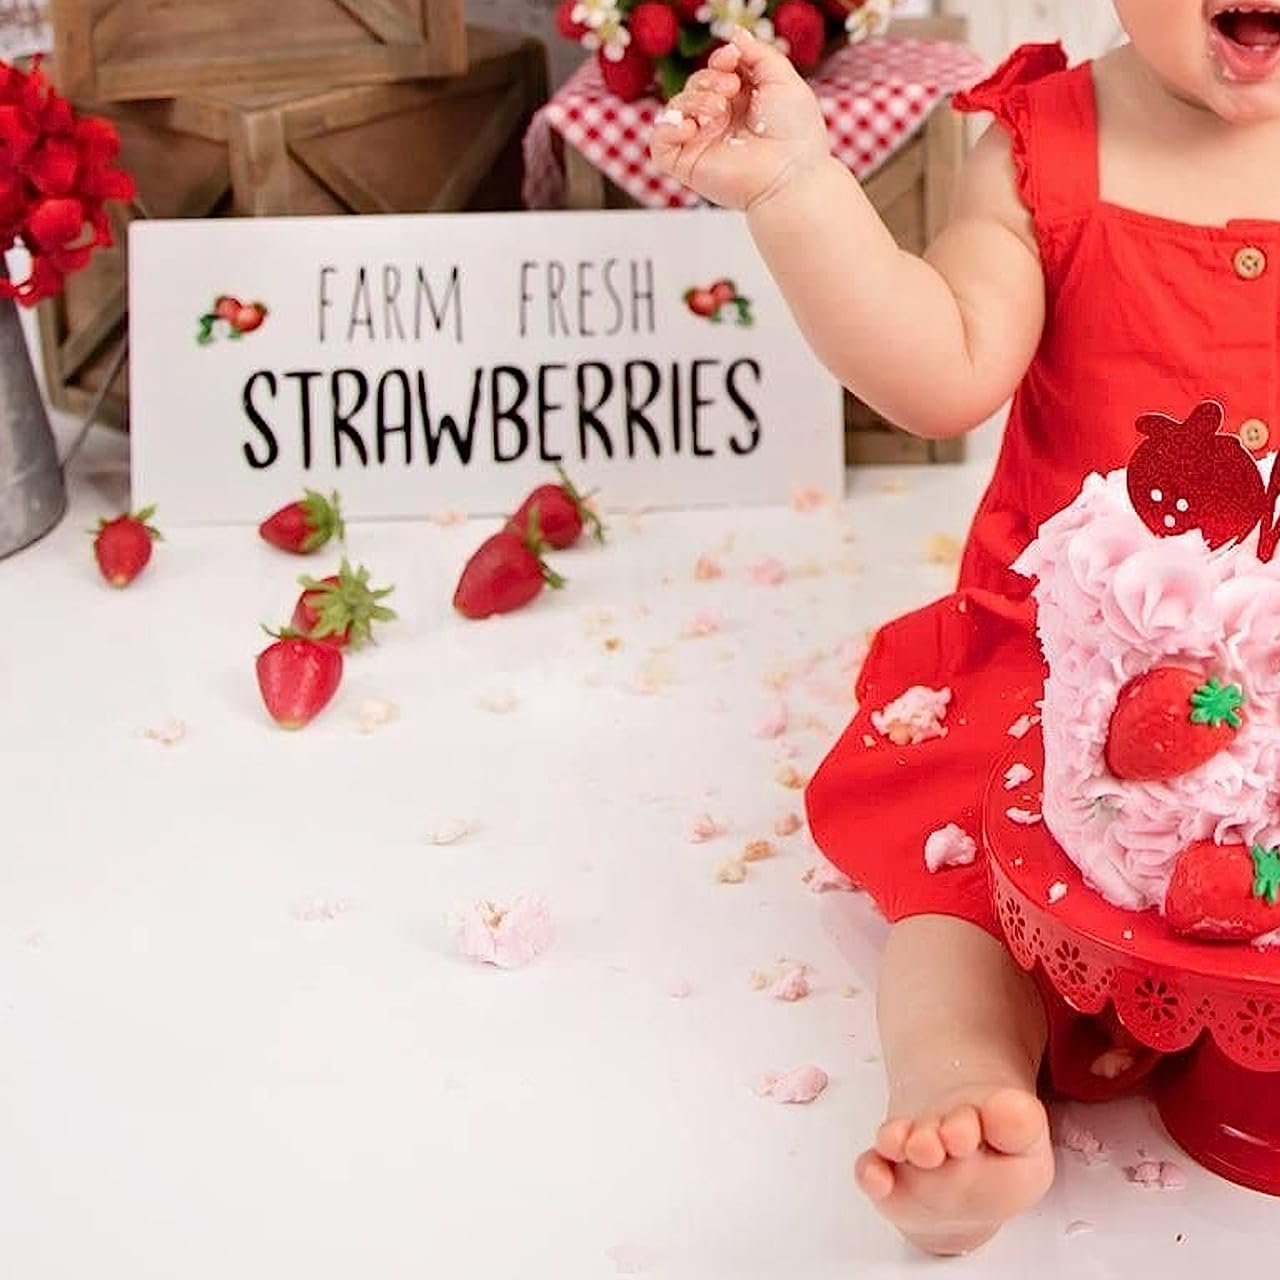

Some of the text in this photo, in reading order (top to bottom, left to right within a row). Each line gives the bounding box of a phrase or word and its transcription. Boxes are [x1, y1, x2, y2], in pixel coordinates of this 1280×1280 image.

[316, 257, 656, 343] FARM FRESH
[241, 357, 762, 471] STRAWBERRIES
